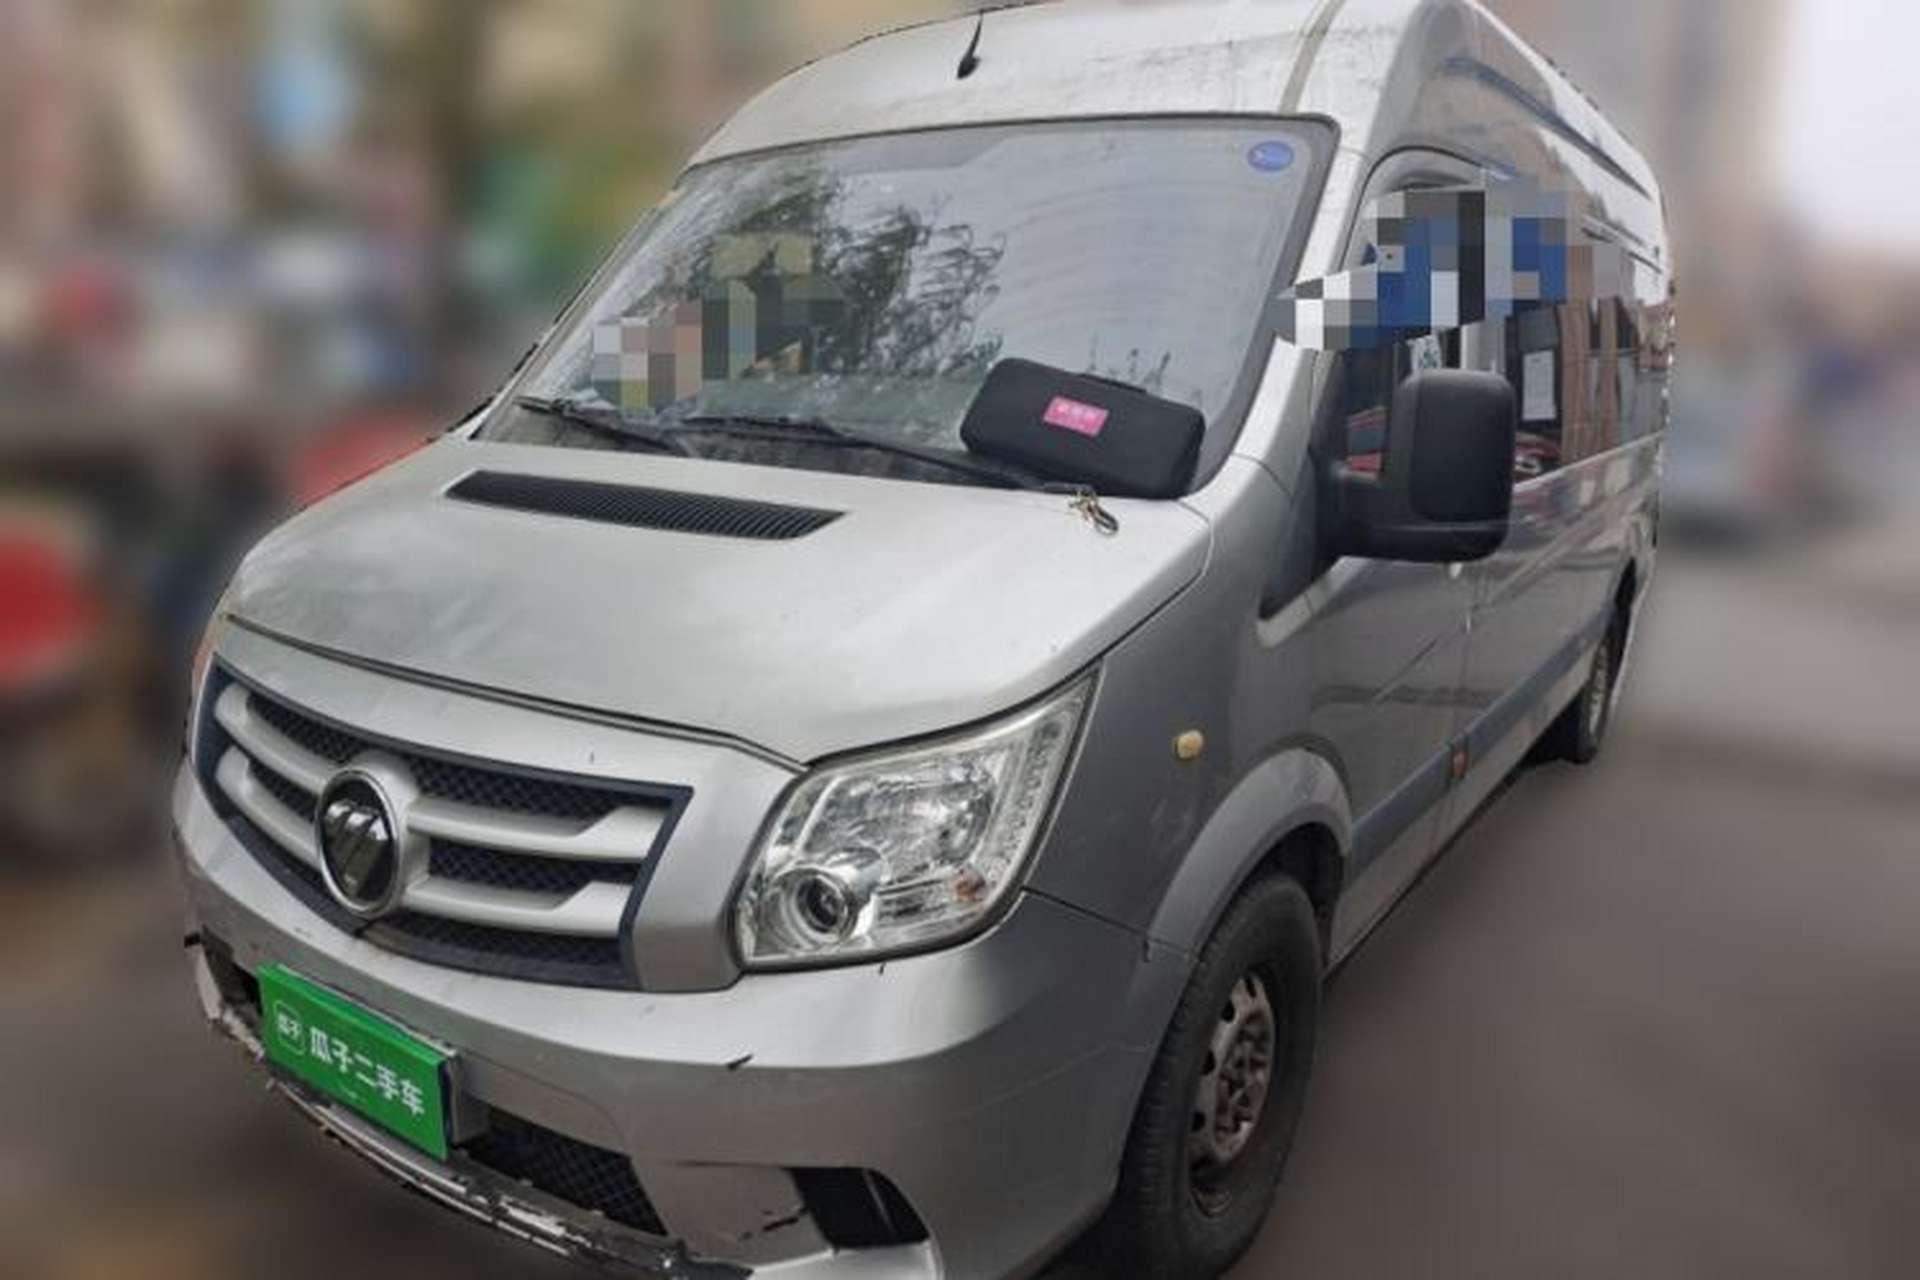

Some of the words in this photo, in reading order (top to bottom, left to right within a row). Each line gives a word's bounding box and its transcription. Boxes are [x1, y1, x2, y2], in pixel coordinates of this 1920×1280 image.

[310, 1026, 425, 1116] 瓜子二手车
